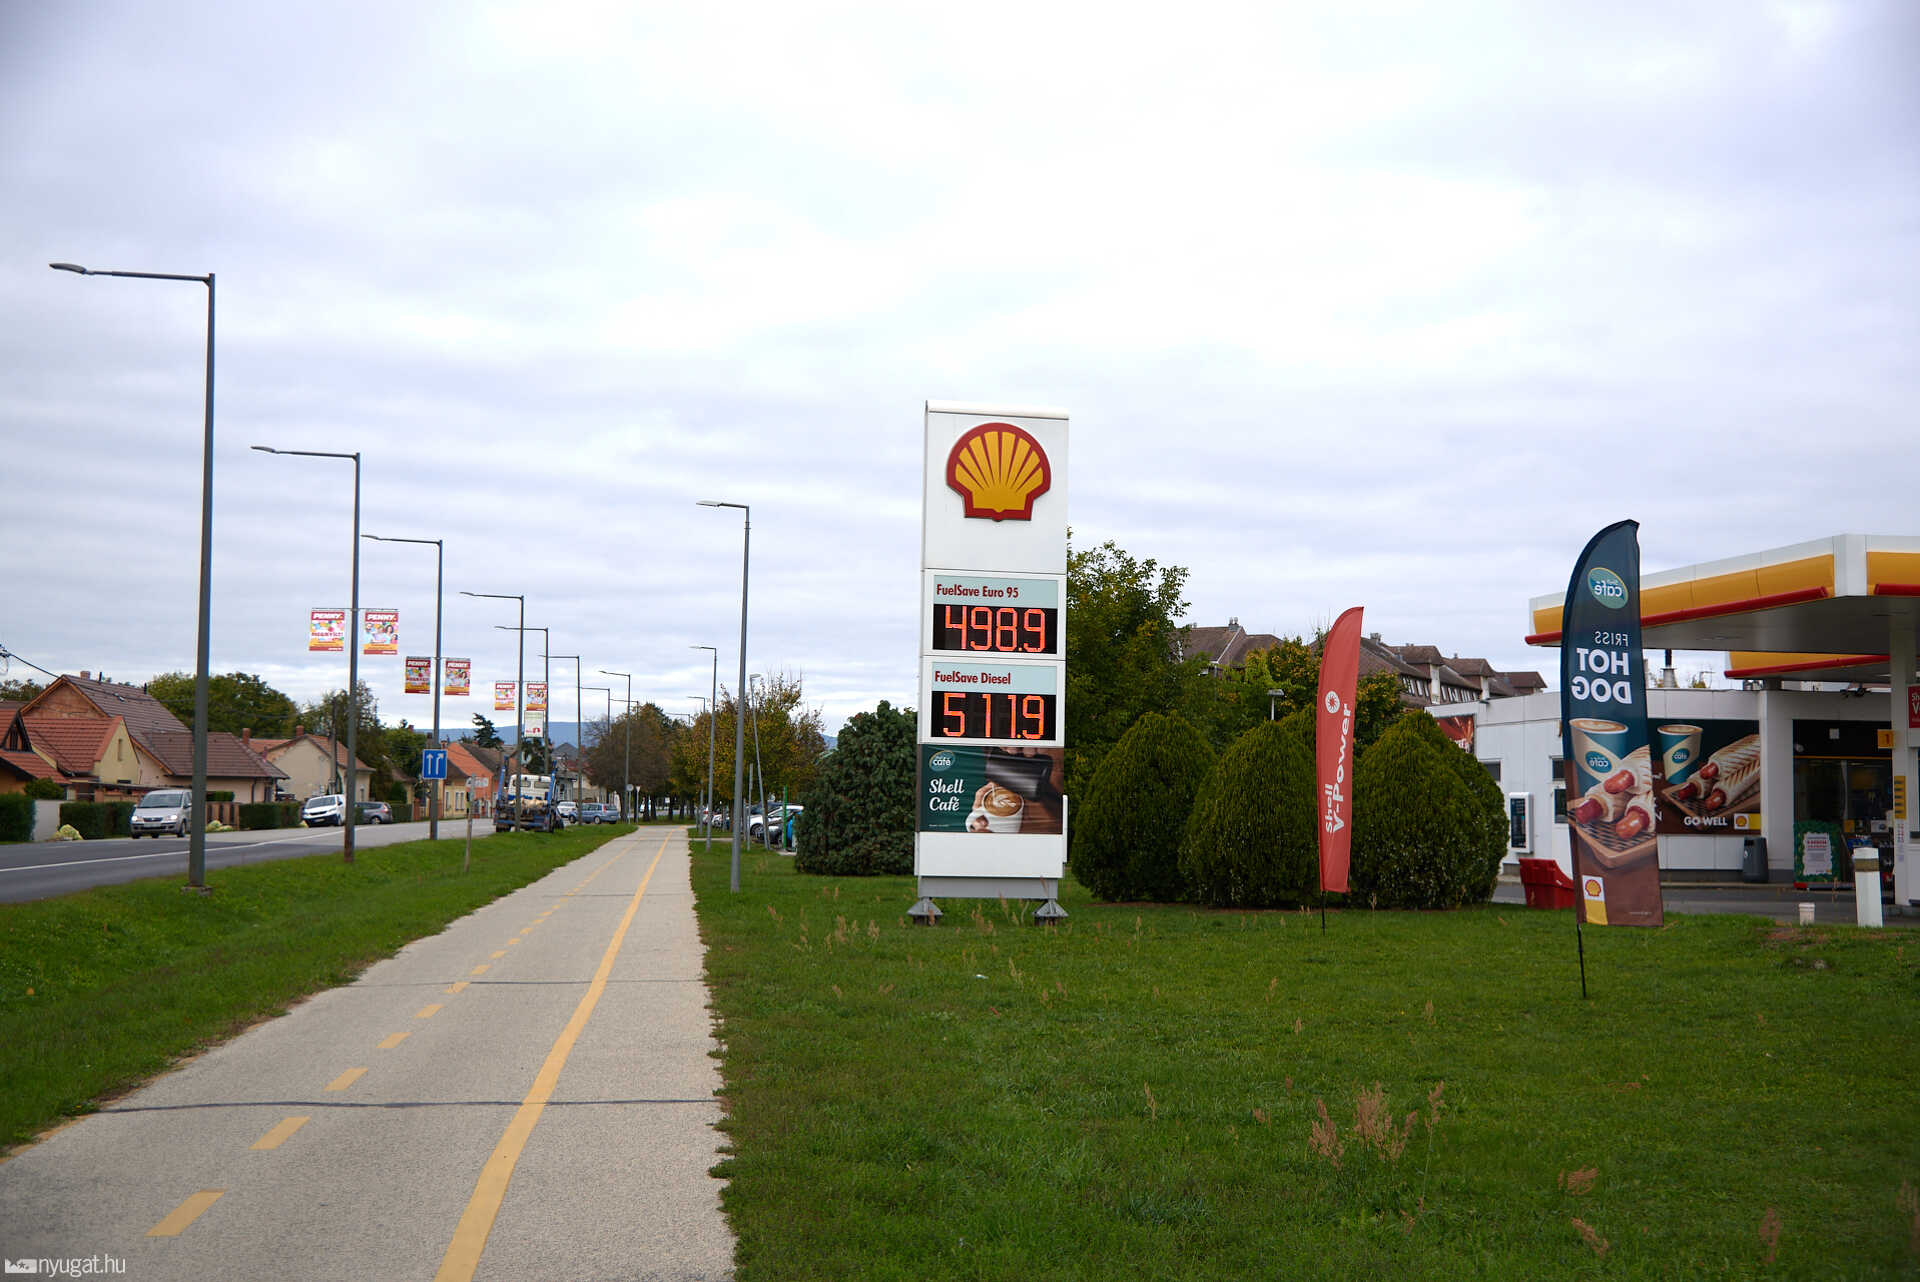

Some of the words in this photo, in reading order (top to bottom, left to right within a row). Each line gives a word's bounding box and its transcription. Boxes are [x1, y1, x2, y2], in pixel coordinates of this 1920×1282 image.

[936, 583, 980, 597] FuelSave
[982, 586, 1004, 598] Euro
[1006, 587, 1019, 598] 95
[945, 605, 1046, 653] 498.9
[934, 670, 979, 684] FuelSave
[981, 672, 1011, 685] Diesel
[943, 692, 1045, 740] 511.9
[1332, 703, 1351, 832] V-Power
[929, 778, 965, 794] Shell
[929, 795, 960, 812] Café
[1324, 783, 1333, 833] Shell
[1683, 816, 1701, 826] GO
[1702, 816, 1728, 826] WELL
